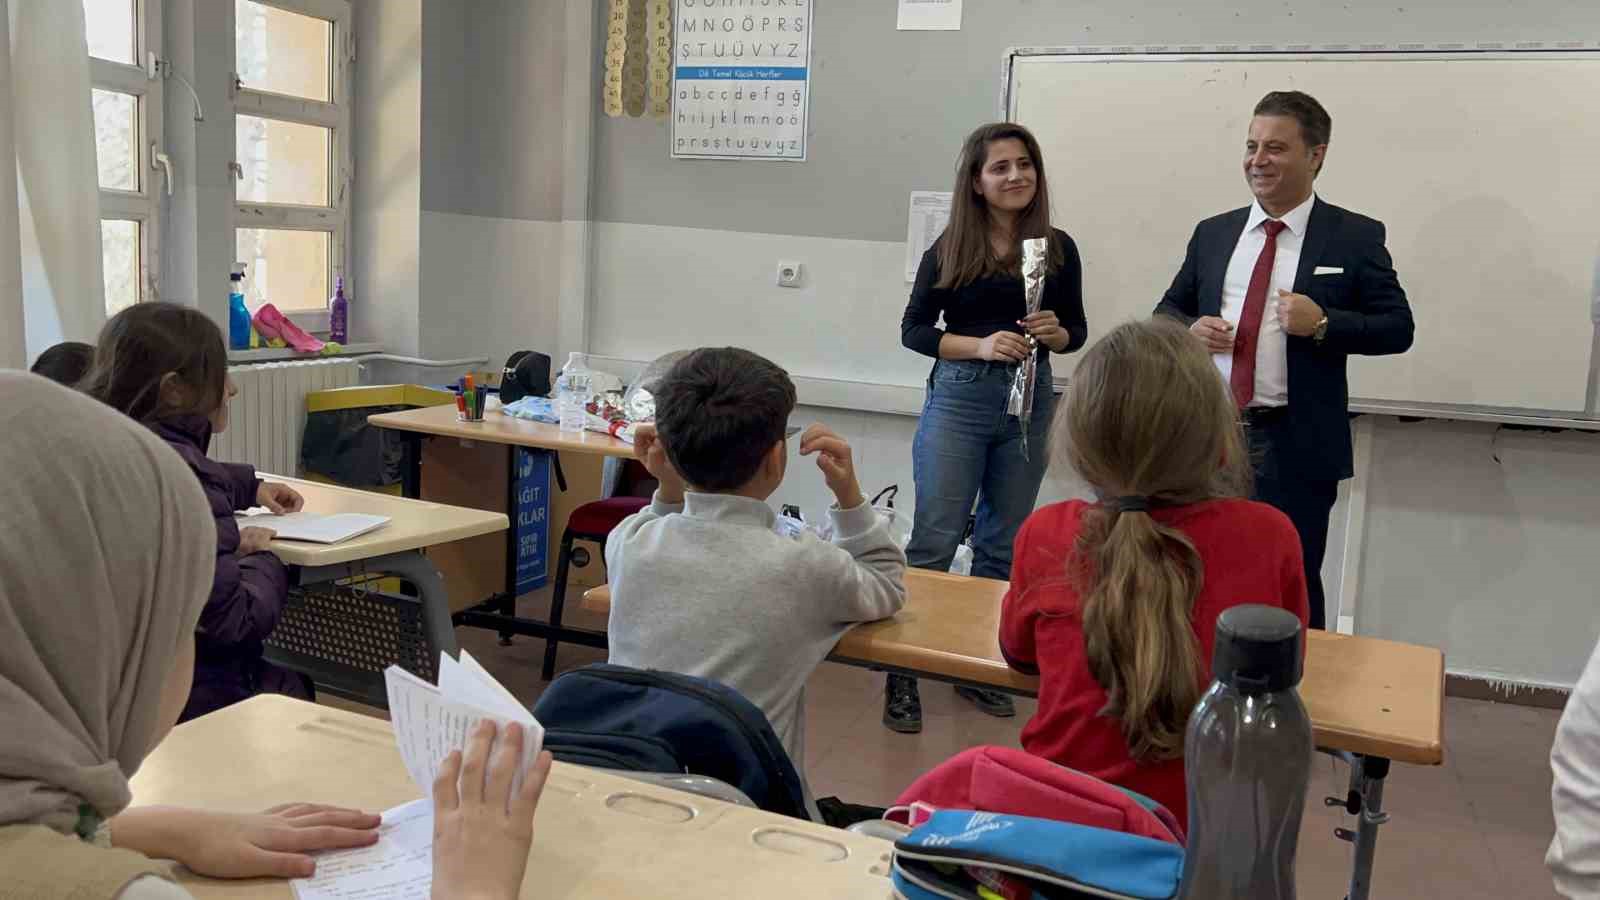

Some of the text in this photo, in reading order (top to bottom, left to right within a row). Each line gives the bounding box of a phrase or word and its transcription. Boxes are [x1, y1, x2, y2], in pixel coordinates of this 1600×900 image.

[683, 15, 804, 32] M N O Ö P R S
[682, 40, 799, 60] Ş T U Ü V Y Z
[712, 69, 732, 78] Temel
[679, 90, 687, 100] a
[693, 86, 701, 100] b
[707, 90, 715, 100] c
[735, 86, 742, 100] d
[749, 91, 757, 100] e
[764, 86, 771, 100] f
[776, 91, 784, 106] g
[678, 110, 685, 123] h
[721, 110, 727, 124] k
[744, 115, 756, 125] m
[761, 115, 770, 125] n
[776, 115, 784, 125] o
[678, 137, 685, 151] p
[690, 138, 697, 149] r
[702, 138, 709, 148] s
[726, 137, 731, 148] t
[736, 138, 744, 149] u
[763, 139, 771, 149] v
[776, 140, 784, 155] y
[789, 140, 797, 150] z
